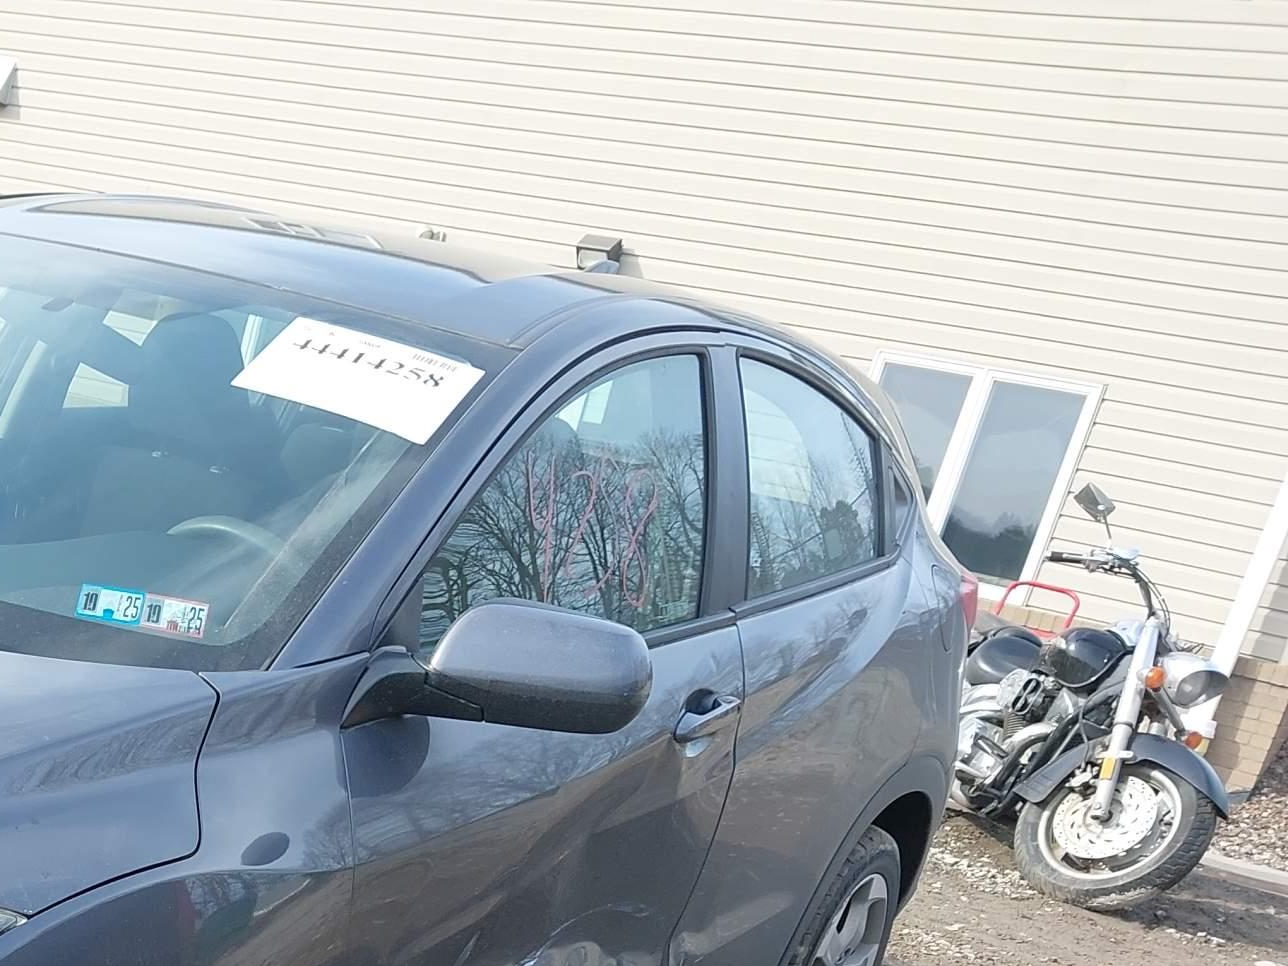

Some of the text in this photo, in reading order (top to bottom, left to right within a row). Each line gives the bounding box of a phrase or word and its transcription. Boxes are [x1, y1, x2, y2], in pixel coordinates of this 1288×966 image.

[293, 339, 445, 388] 44414258
[123, 596, 141, 619] 25
[187, 606, 205, 631] 25
